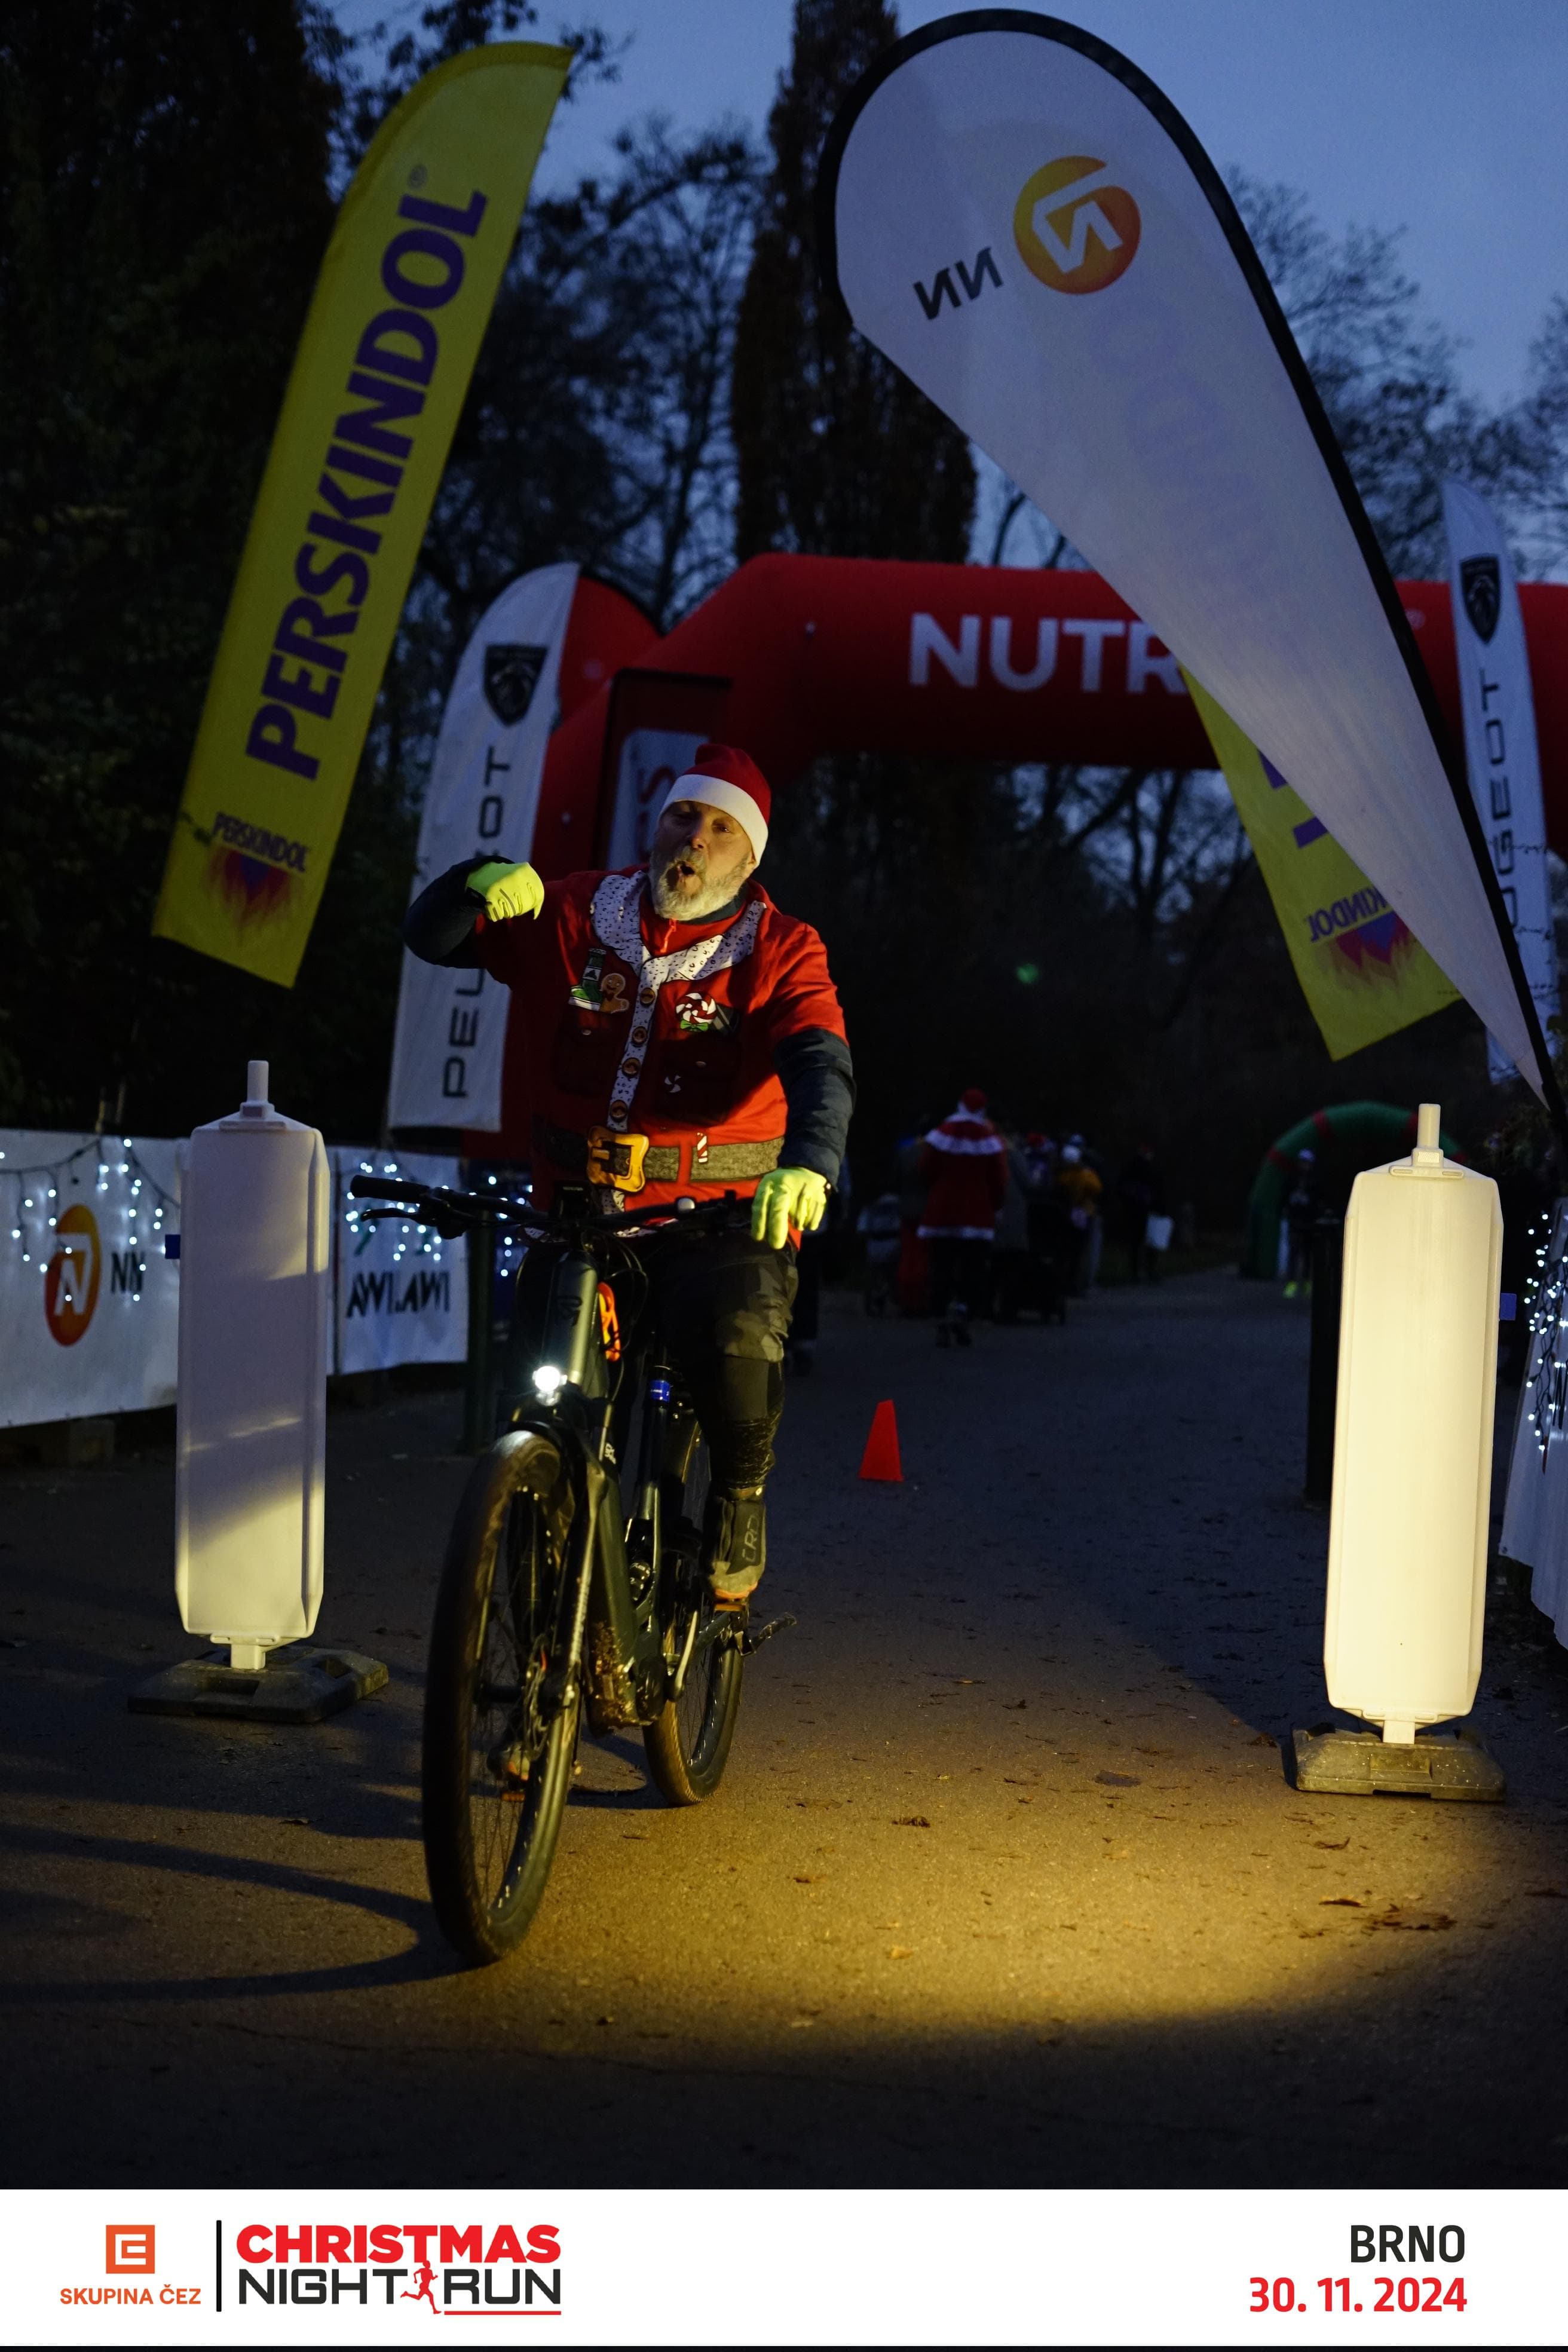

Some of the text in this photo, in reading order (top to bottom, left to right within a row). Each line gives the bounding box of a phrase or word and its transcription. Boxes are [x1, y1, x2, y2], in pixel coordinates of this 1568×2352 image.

[245, 191, 486, 780] PERSKINDOL
[908, 612, 1191, 696] NUTR
[1479, 667, 1518, 929] UGEOT
[111, 1252, 145, 1294] NN
